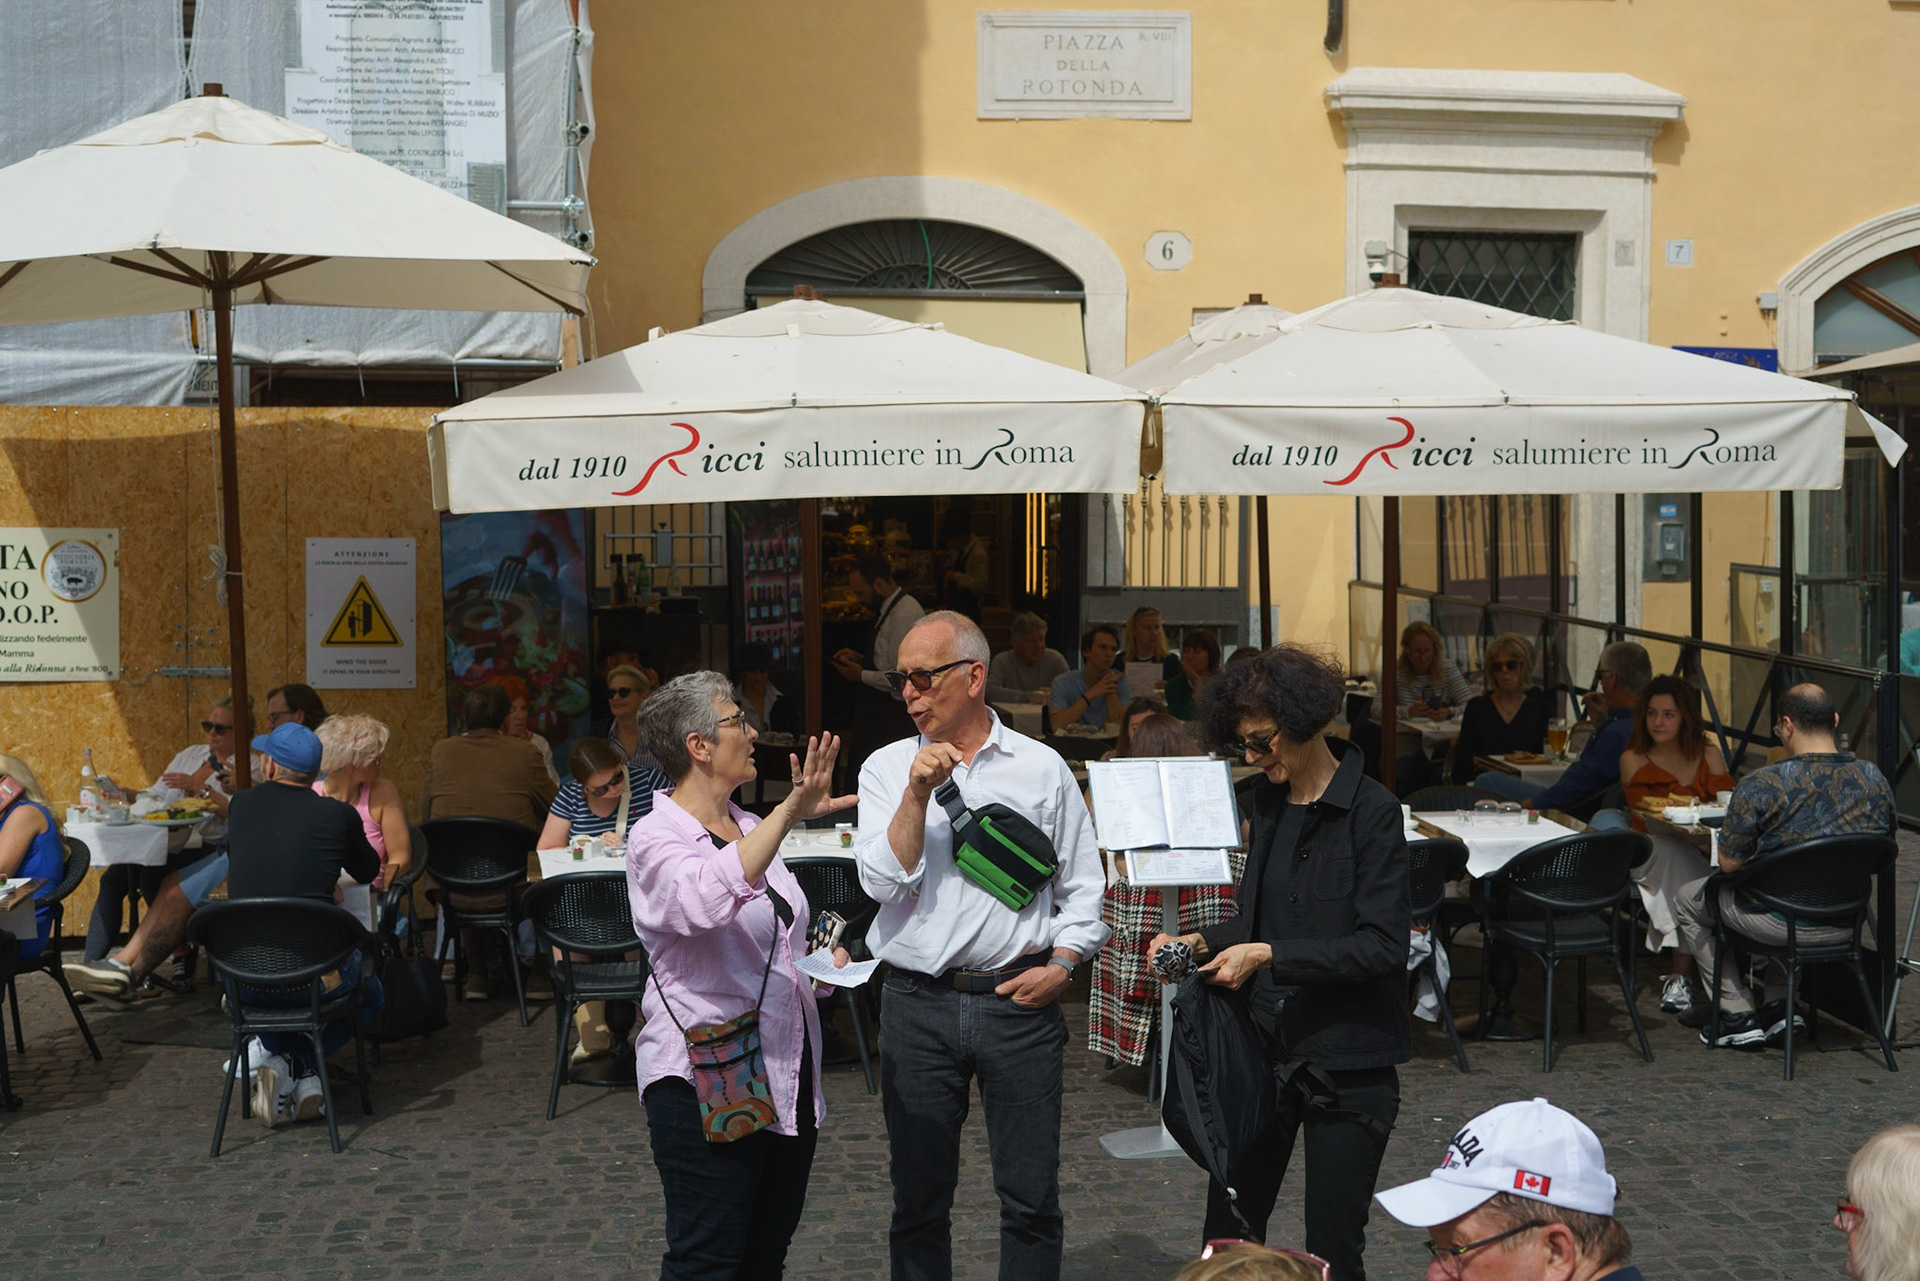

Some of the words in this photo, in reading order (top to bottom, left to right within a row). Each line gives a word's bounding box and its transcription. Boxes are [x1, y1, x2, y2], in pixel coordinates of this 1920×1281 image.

[1044, 34, 1124, 50] PIAZZA
[1057, 60, 1110, 71] DELLA
[1022, 79, 1143, 96] ROTONDA
[1162, 240, 1174, 261] 6
[1675, 244, 1685, 259] 7
[1232, 444, 1273, 466] dal
[1282, 445, 1339, 467] 1910
[1322, 416, 1476, 486] Ricci
[1492, 438, 1632, 466] salumiere
[1641, 438, 1669, 465] in
[1667, 427, 1778, 470] Roma
[519, 458, 560, 481] dal
[569, 455, 627, 479] 1910
[611, 422, 766, 497] Ricci
[784, 440, 925, 469] salumiere
[935, 439, 963, 466] in
[962, 428, 1076, 471] Roma
[37, 634, 88, 643] fedelmente
[0, 649, 35, 658] Mamma
[3, 663, 22, 673] alla
[25, 663, 66, 673] Ridonna
